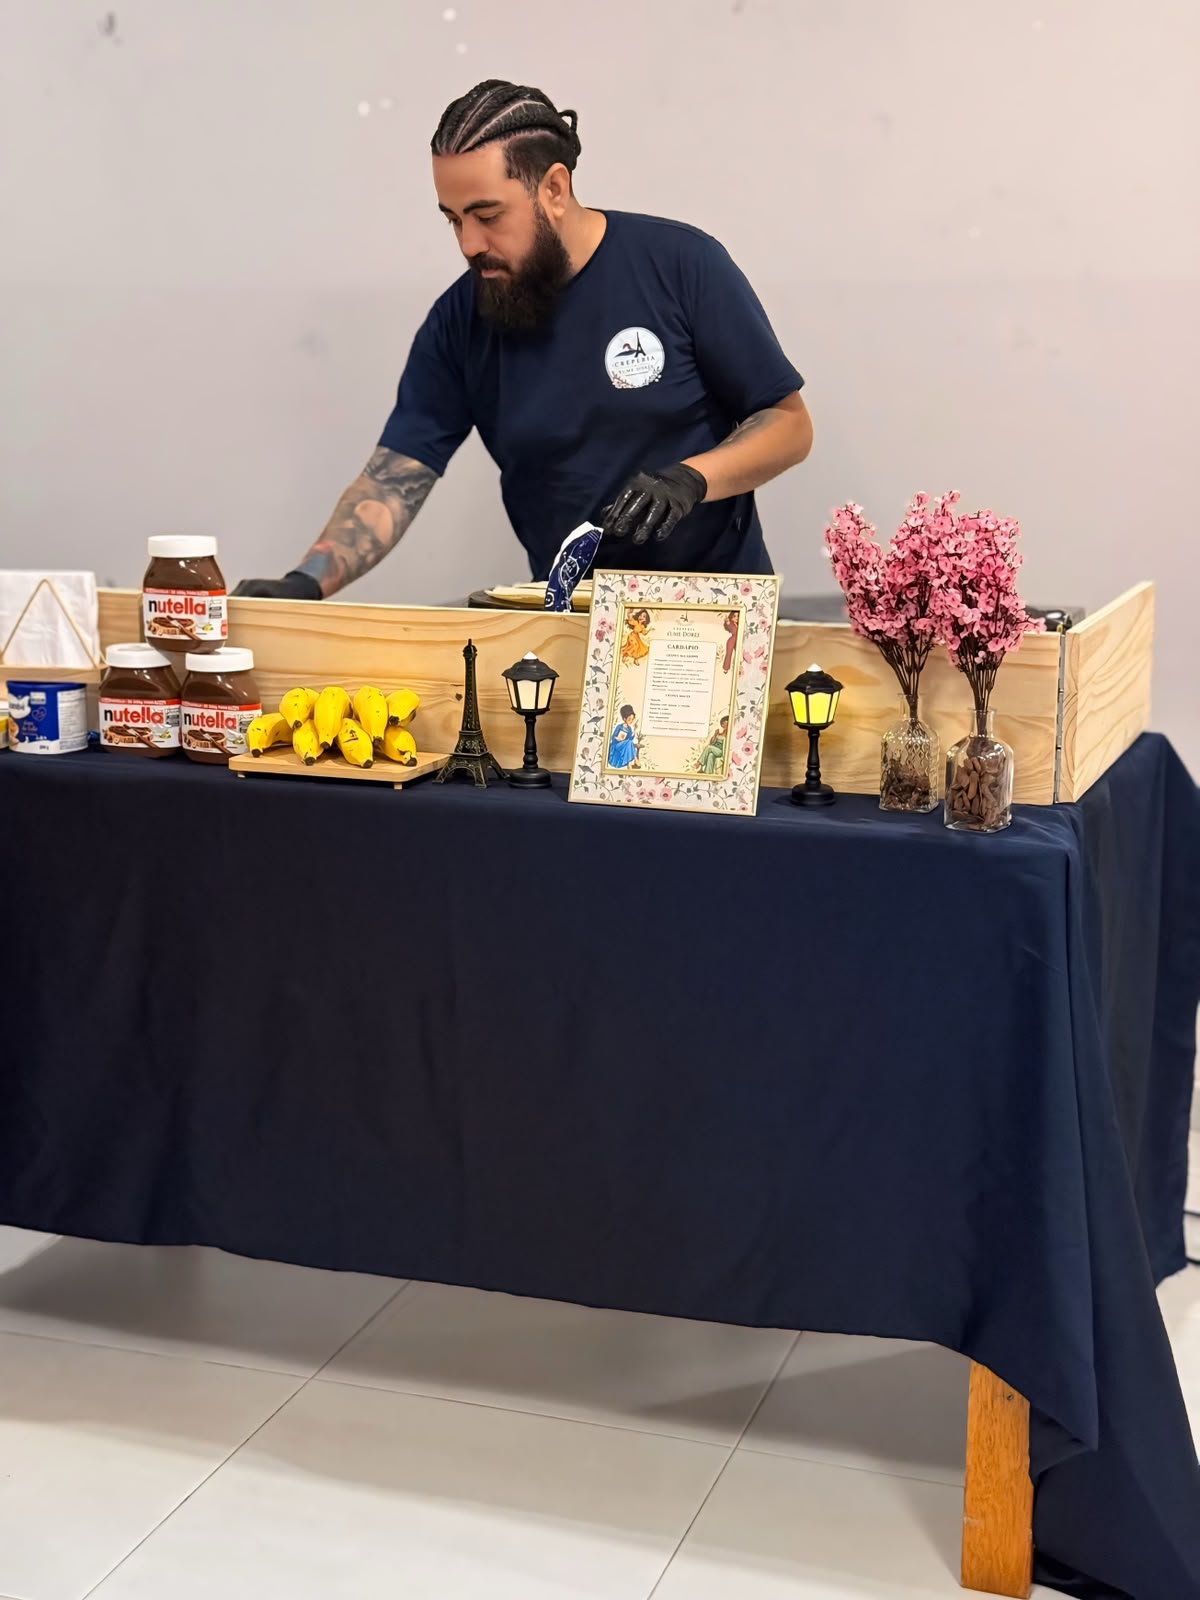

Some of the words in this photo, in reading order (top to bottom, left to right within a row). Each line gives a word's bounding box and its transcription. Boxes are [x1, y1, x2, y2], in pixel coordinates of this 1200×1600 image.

[614, 355, 656, 367] CREPERIA
[148, 597, 207, 616] nutella
[104, 706, 164, 724] nutella
[183, 711, 237, 730] nutella
